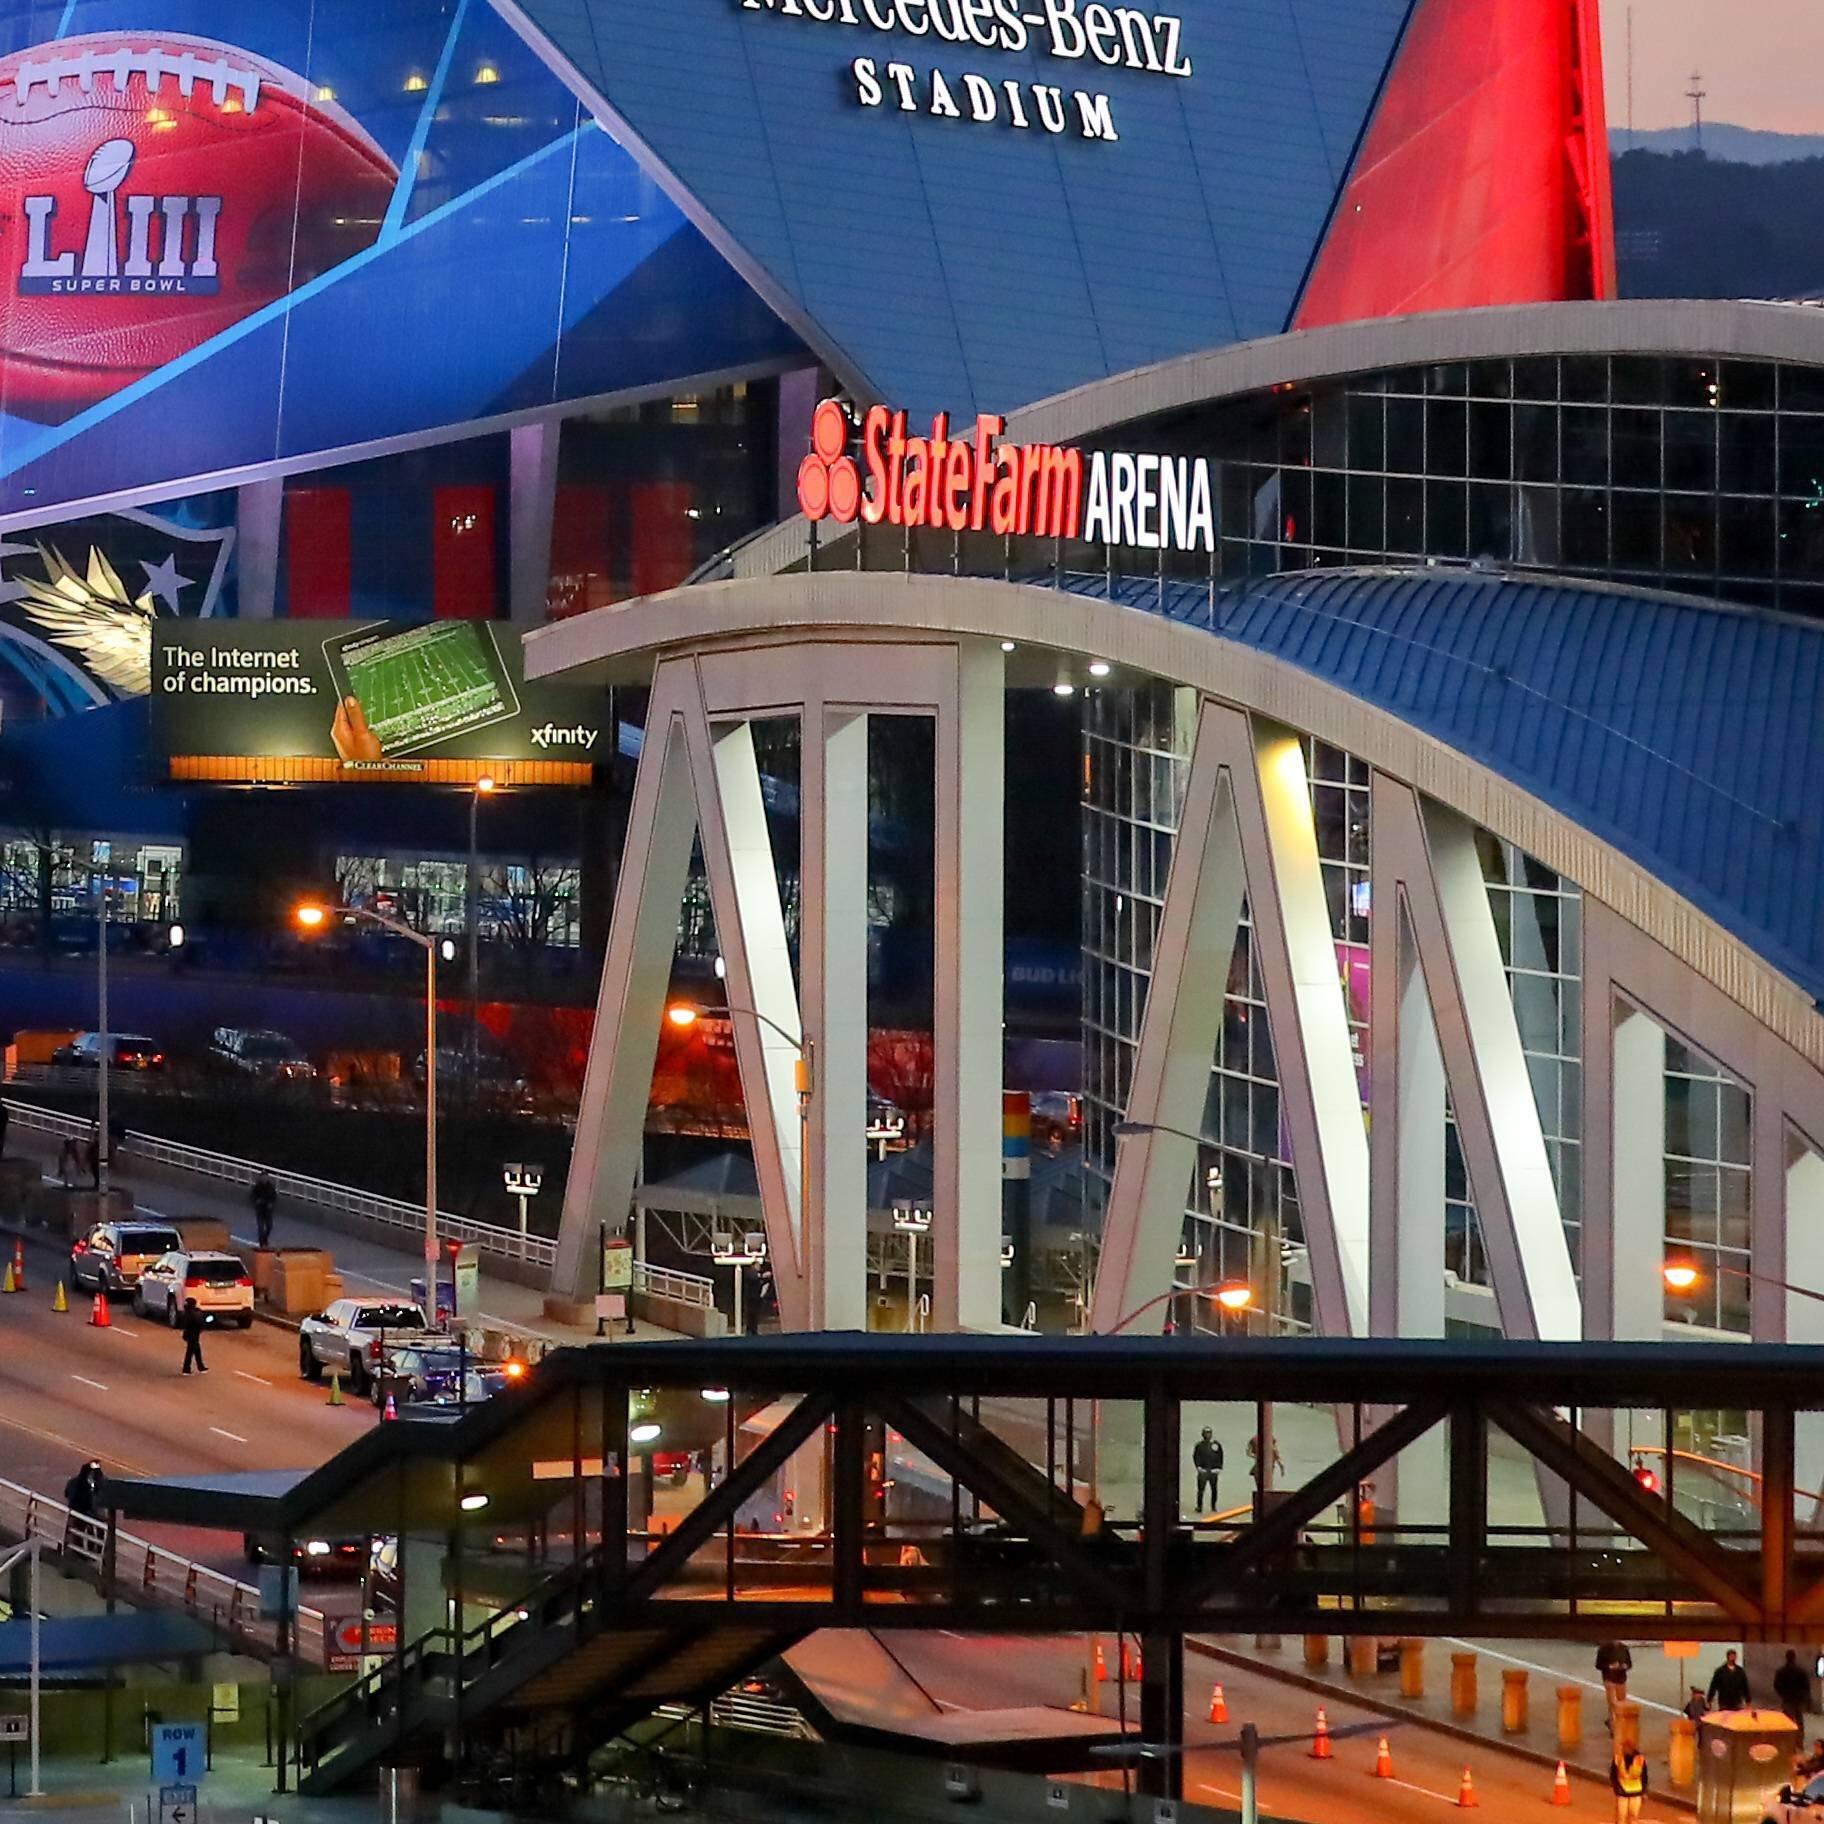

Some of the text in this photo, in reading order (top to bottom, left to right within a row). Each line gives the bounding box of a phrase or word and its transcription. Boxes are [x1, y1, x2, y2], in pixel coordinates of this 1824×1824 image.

[852, 57, 1120, 142] STADIUM
[22, 195, 222, 278] LIII
[52, 279, 186, 292] SUPER BOWL
[1084, 449, 1216, 553] ARENA
[162, 646, 300, 670] The Internet
[162, 671, 318, 699] of champions.
[530, 722, 599, 749] xfinity
[163, 1728, 196, 1741] ROW
[173, 1747, 186, 1776] 1
